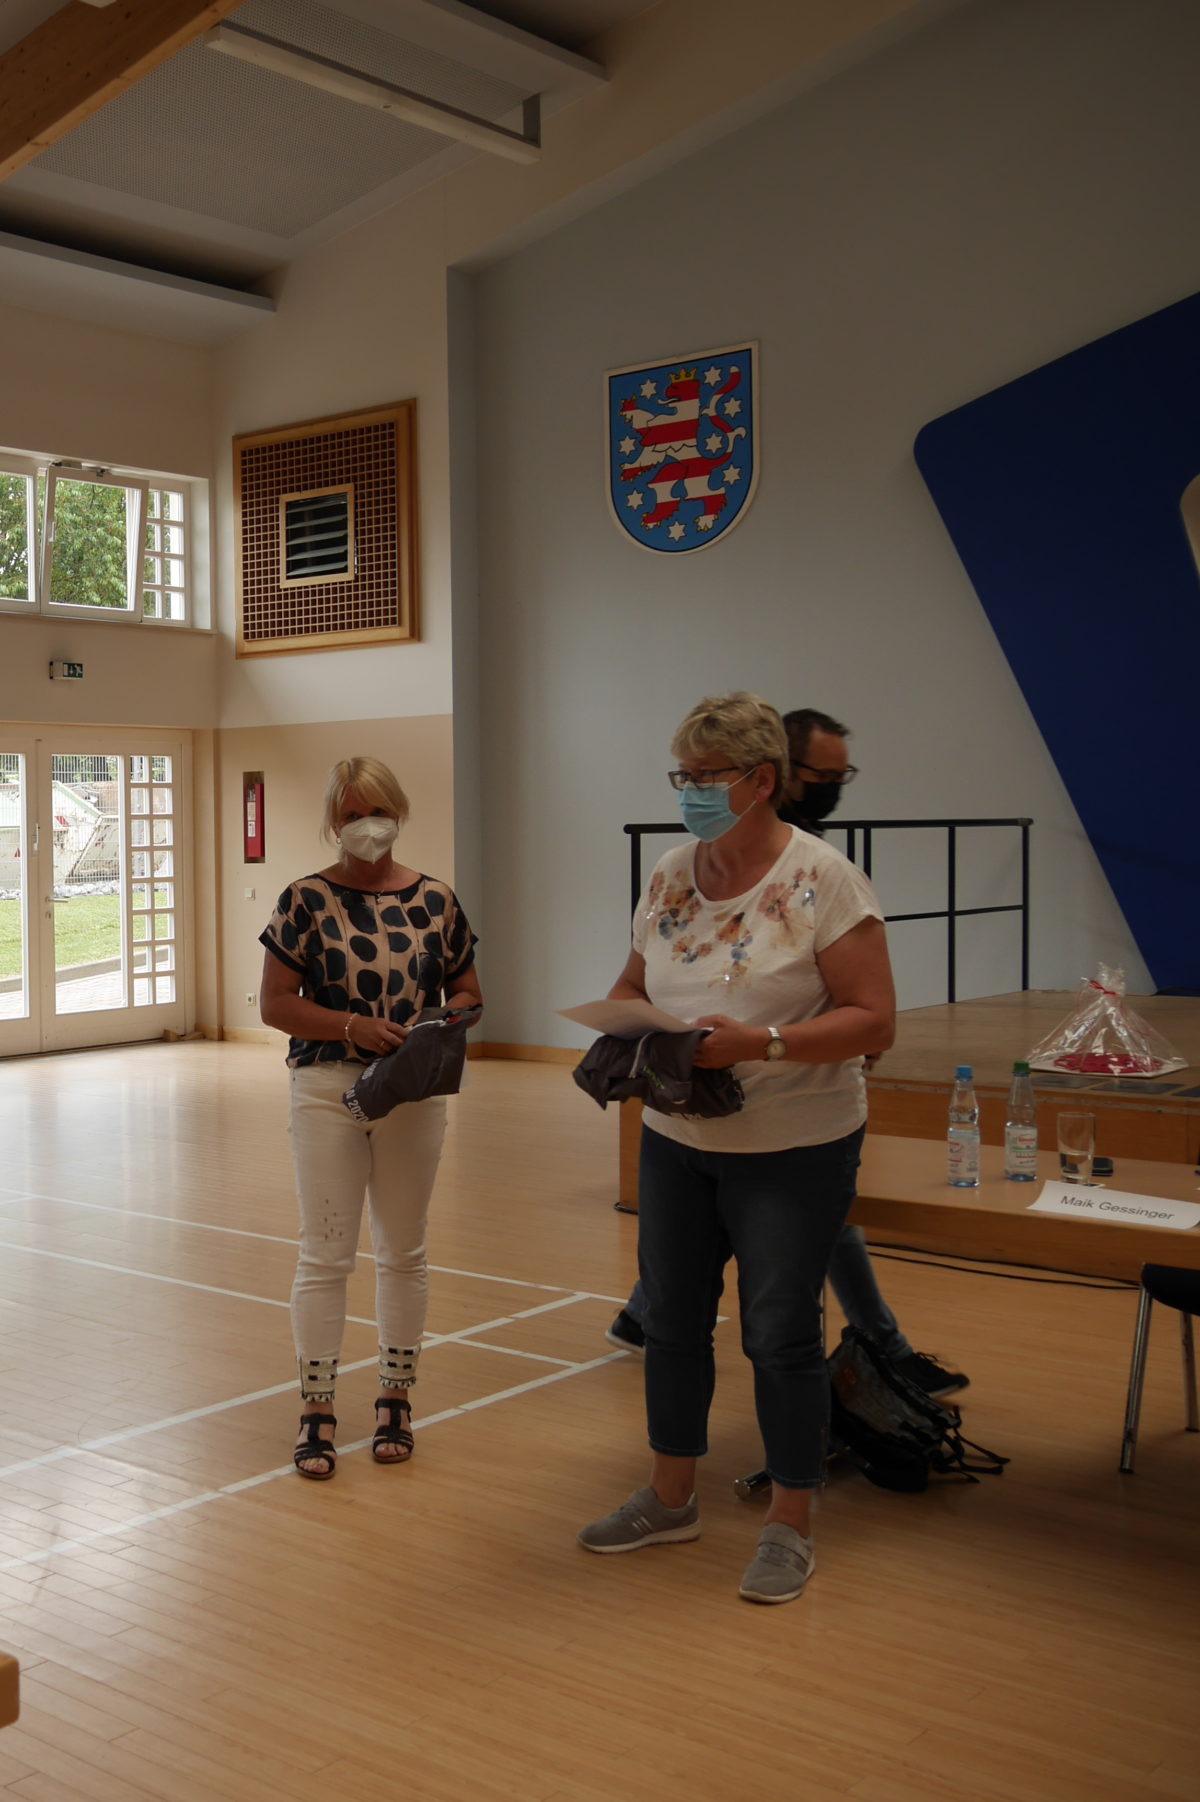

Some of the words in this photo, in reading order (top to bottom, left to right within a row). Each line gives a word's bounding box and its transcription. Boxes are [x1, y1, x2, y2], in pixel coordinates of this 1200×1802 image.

[347, 1099, 370, 1123] 2020
[1059, 1195, 1095, 1209] Maik
[1098, 1200, 1176, 1220] Gessinger
